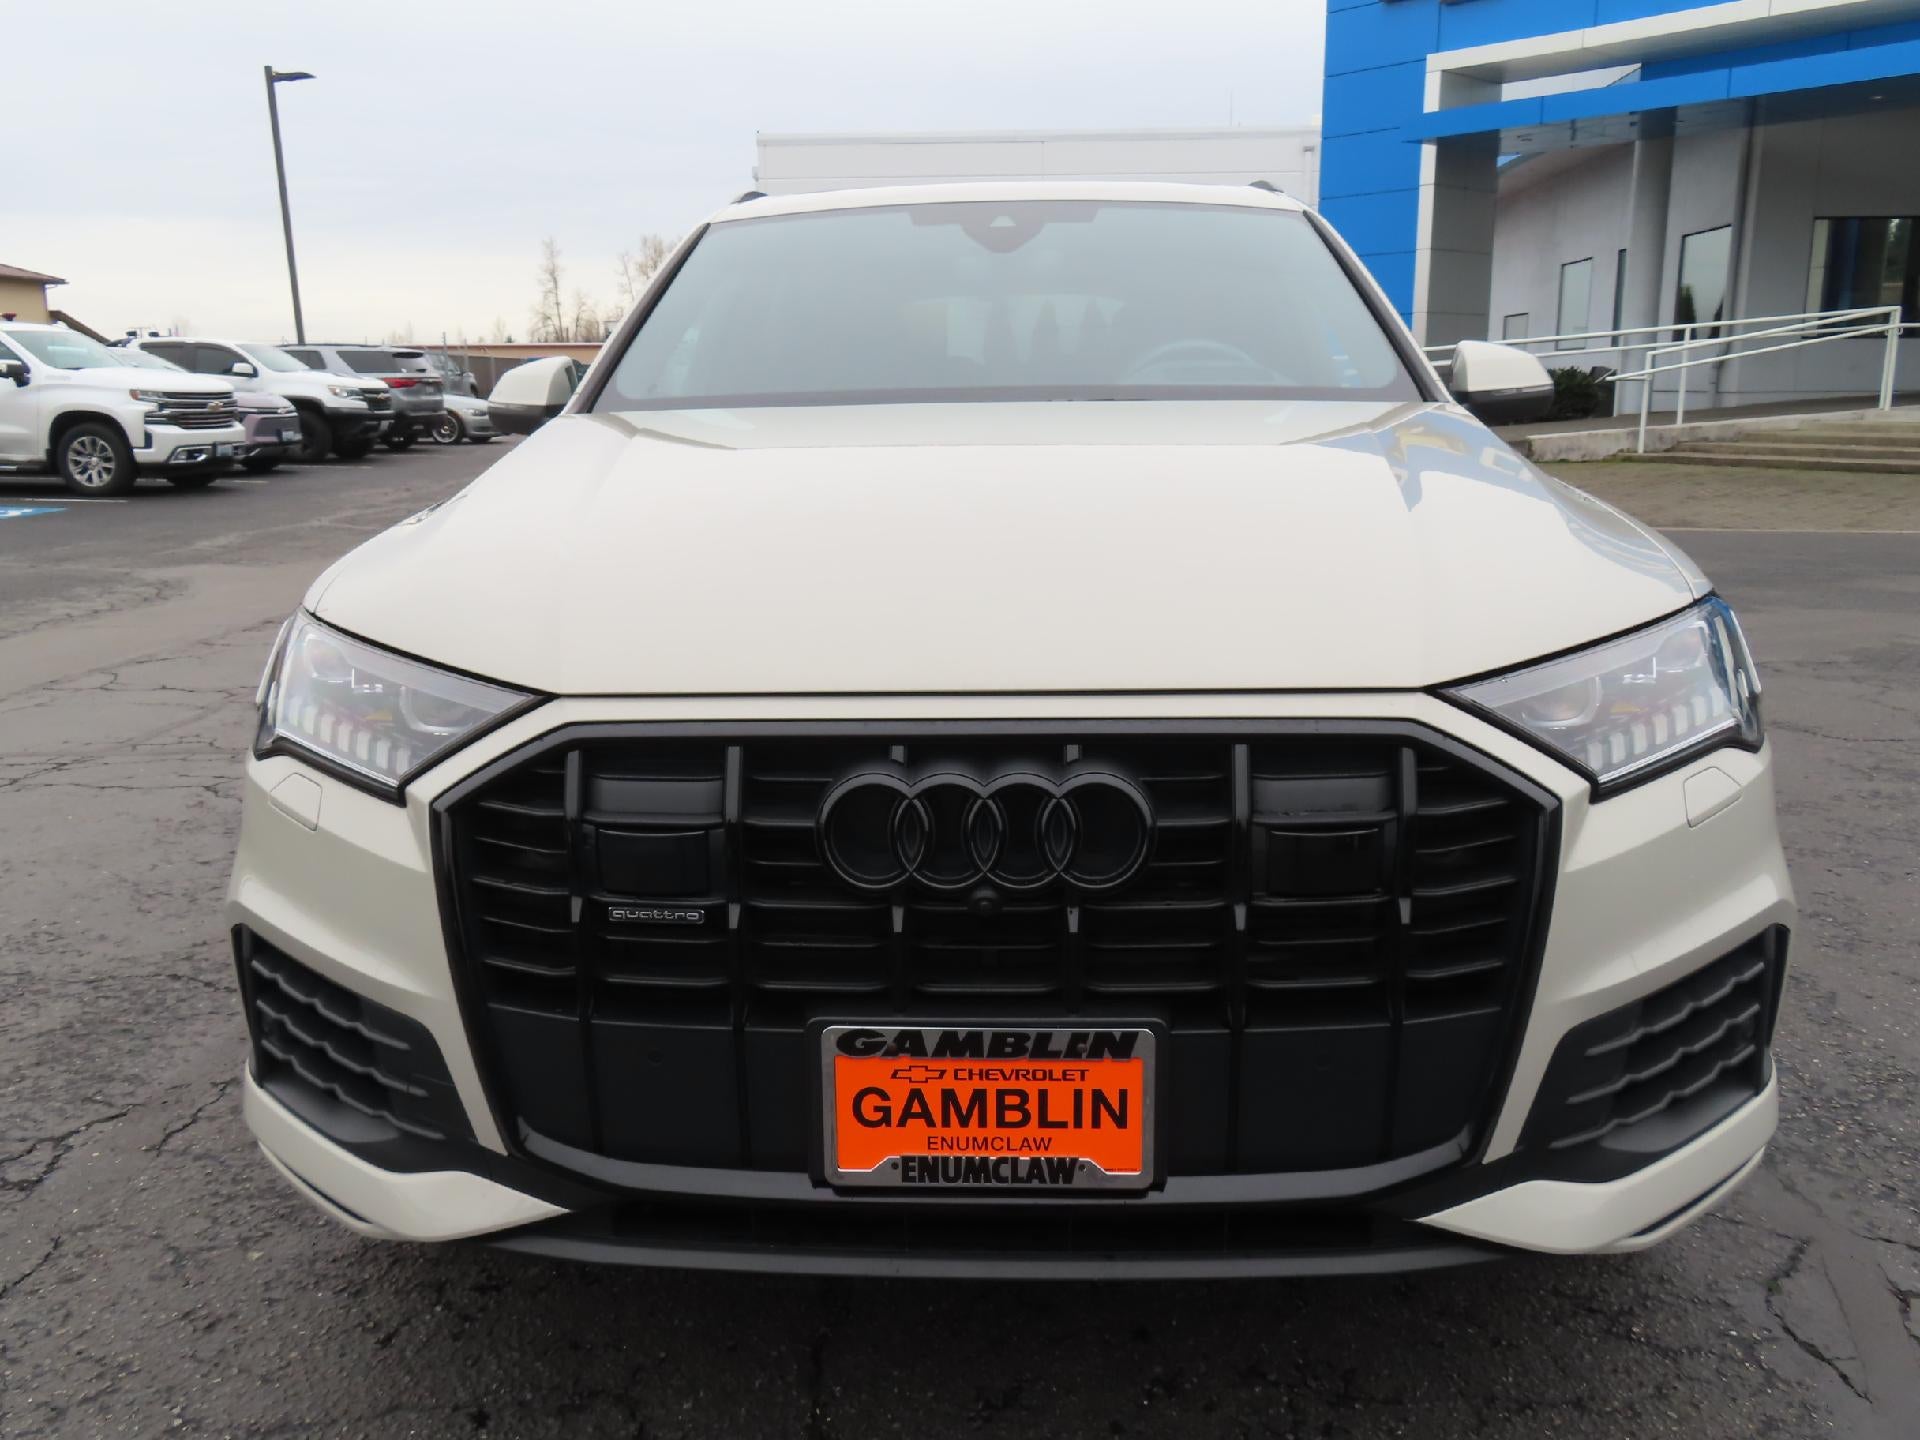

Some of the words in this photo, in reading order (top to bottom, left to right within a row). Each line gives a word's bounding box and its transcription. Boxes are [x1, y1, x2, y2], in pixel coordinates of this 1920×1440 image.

[612, 910, 700, 920] quattro
[837, 1028, 1140, 1060] GAMBLIN
[953, 1068, 1090, 1082] CHEVROLET
[852, 1086, 1128, 1129] GAMBLIN
[927, 1136, 1053, 1152] ENUMCLAW
[901, 1156, 1080, 1185] ENUMCLAW
